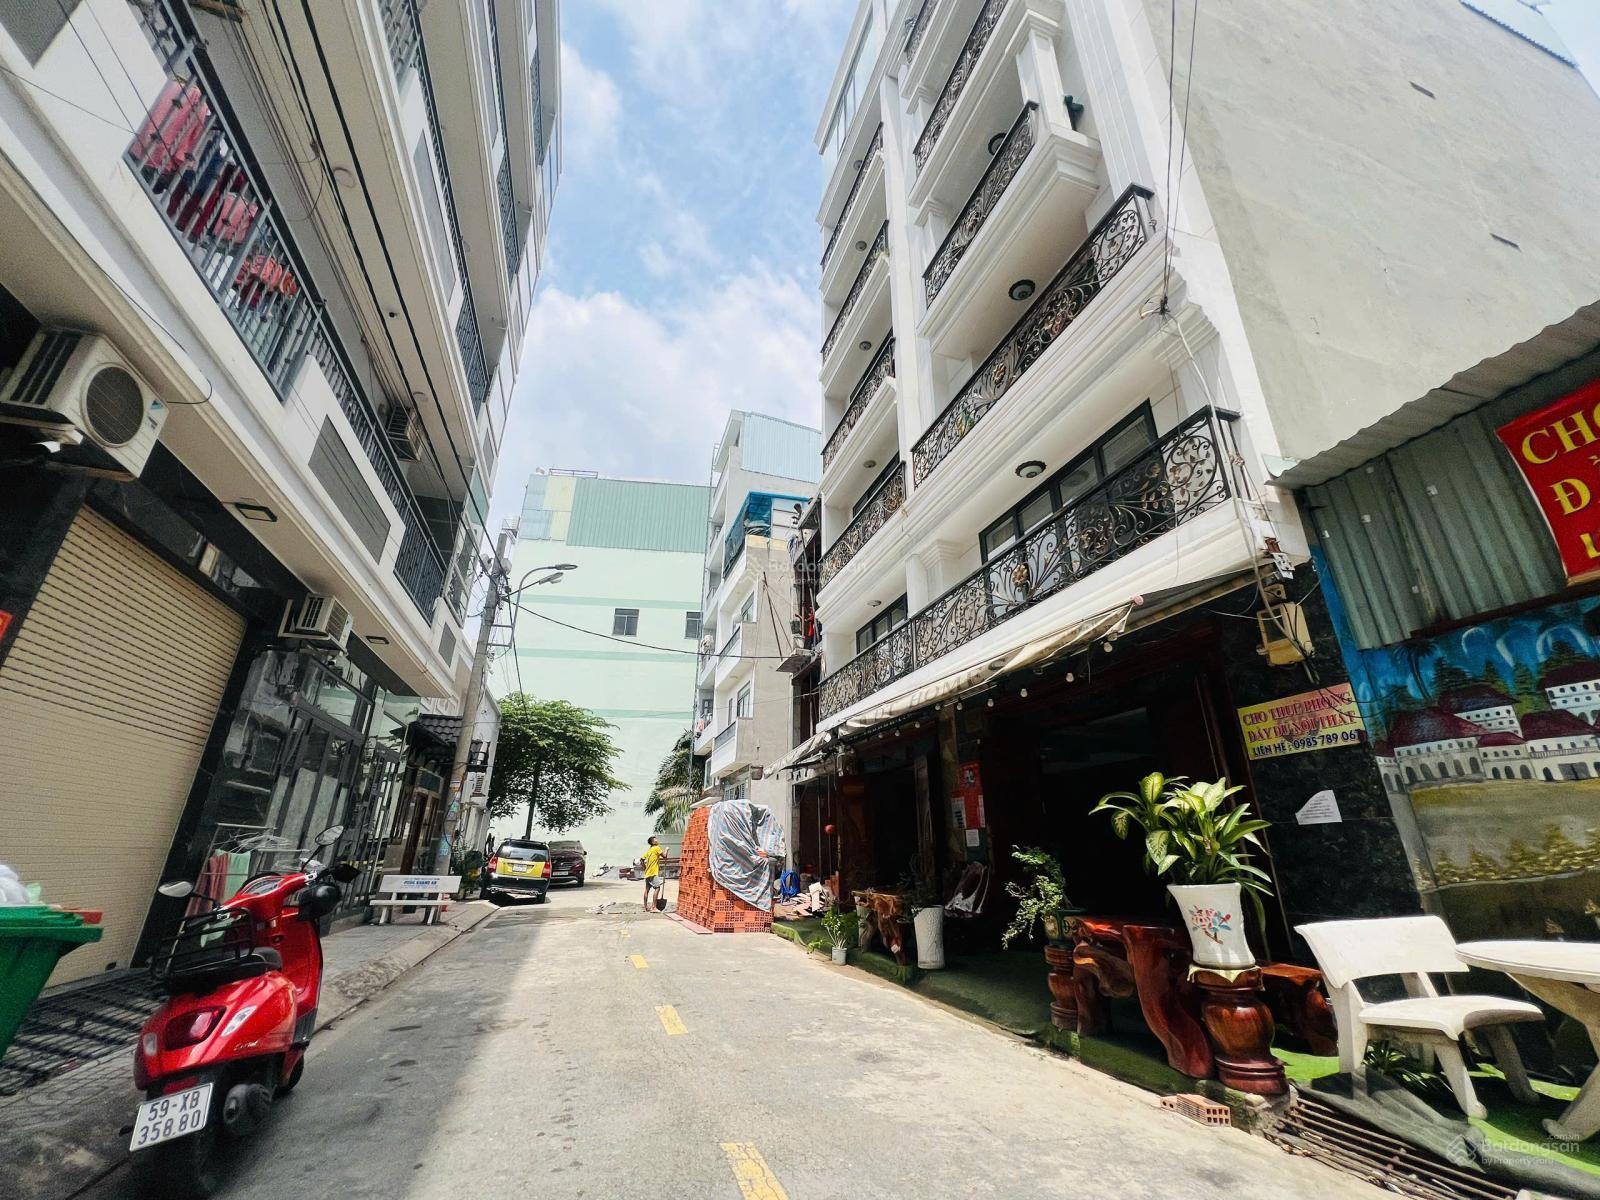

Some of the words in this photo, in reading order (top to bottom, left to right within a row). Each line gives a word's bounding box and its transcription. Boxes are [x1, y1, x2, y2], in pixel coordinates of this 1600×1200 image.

[1522, 402, 1600, 464] CH
[1292, 735, 1317, 749] 0985
[1319, 732, 1338, 744] 789
[138, 1110, 201, 1145] 358.80
